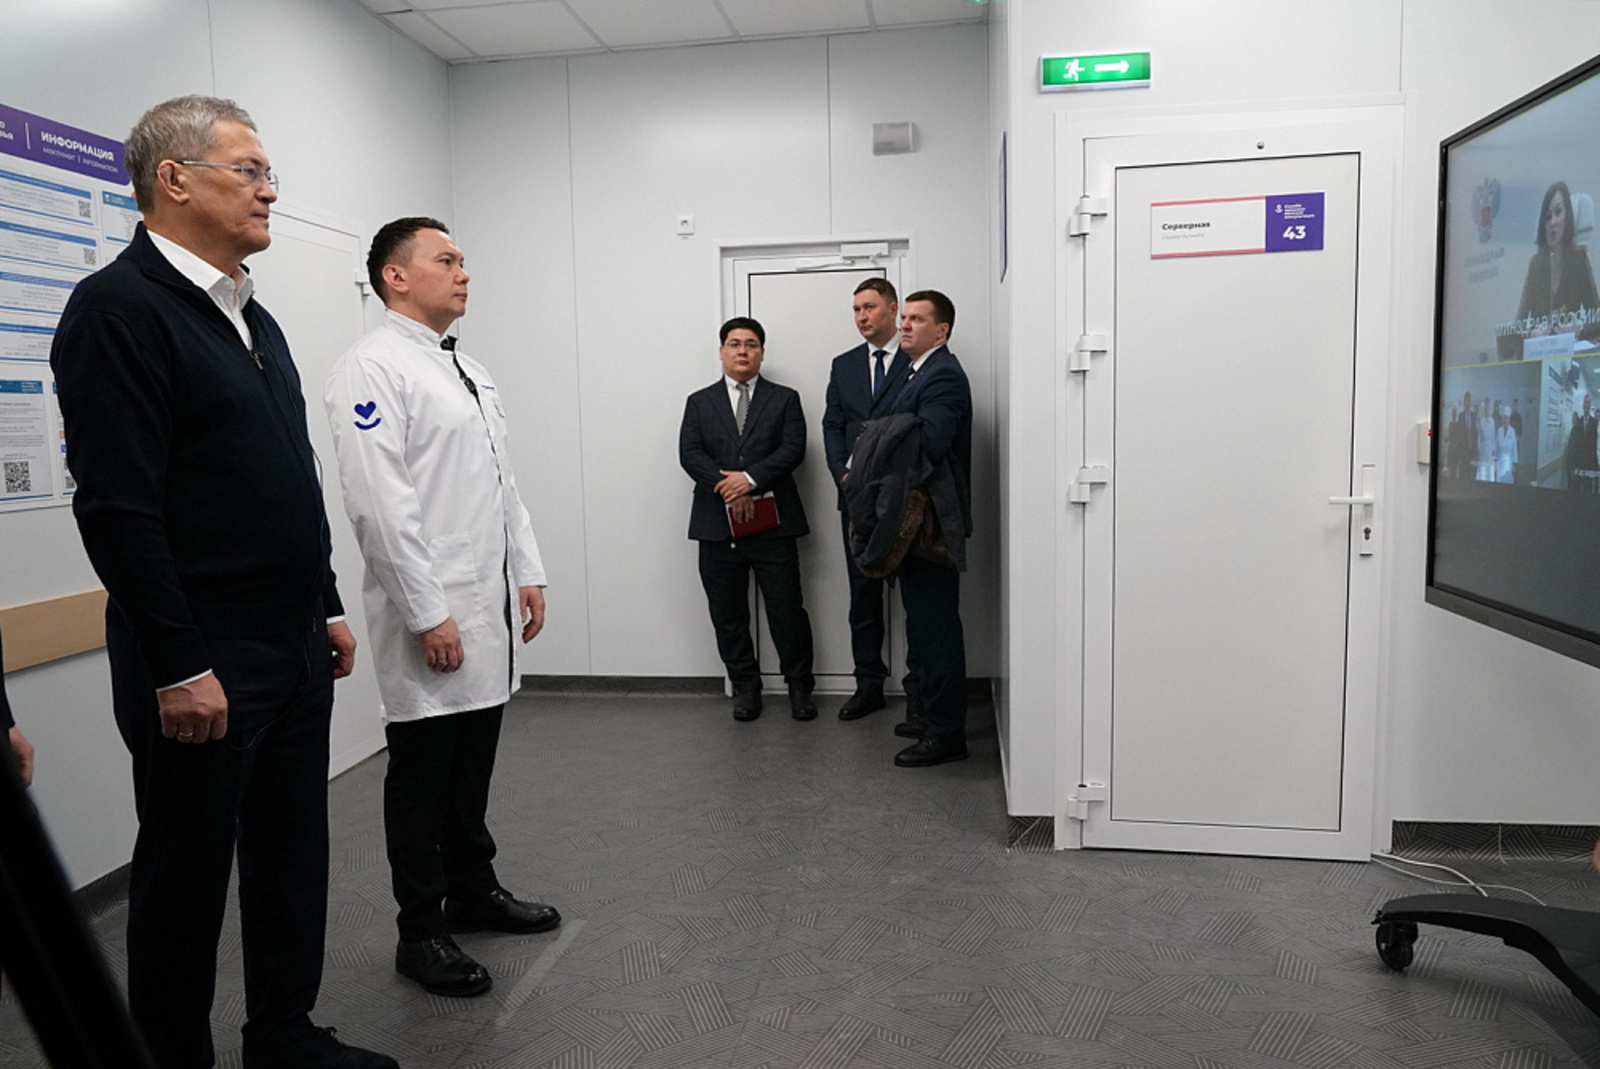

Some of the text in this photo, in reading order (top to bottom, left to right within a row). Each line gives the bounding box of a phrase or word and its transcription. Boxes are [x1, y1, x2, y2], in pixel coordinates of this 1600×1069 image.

[41, 131, 115, 162] ИНФОРМАЦИЯ
[82, 158, 118, 174] INFORMATION
[1162, 221, 1211, 231] Серверная
[1282, 225, 1307, 240] 43
